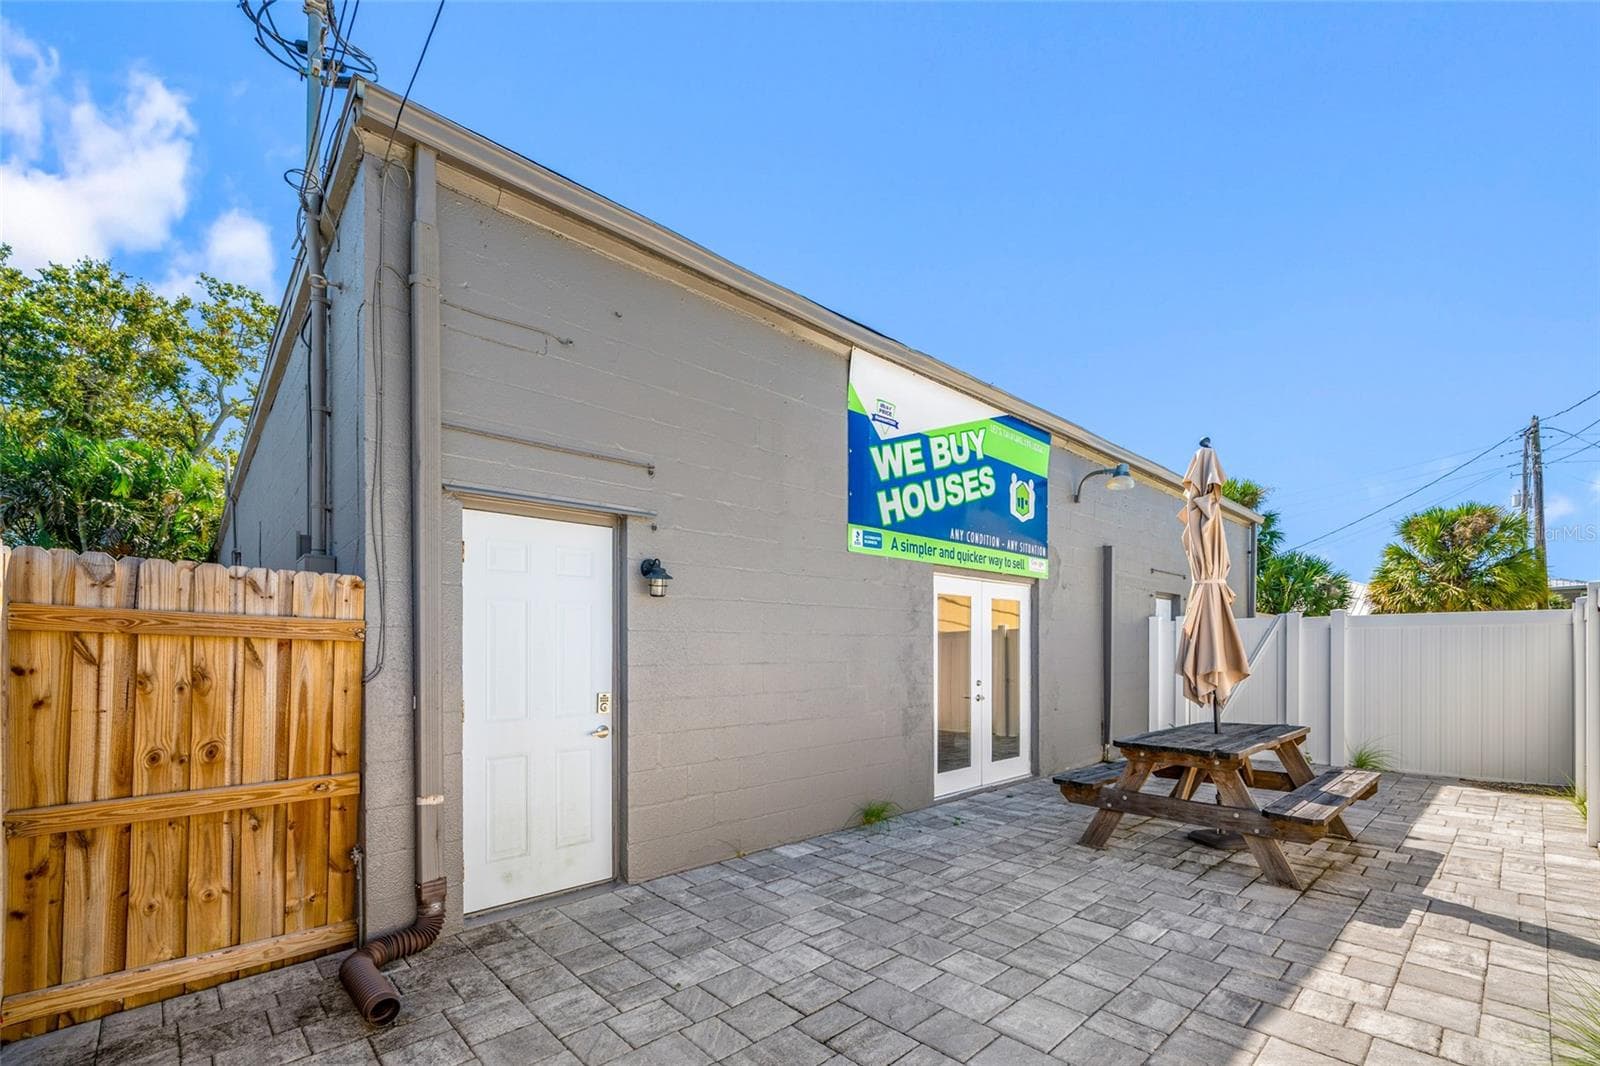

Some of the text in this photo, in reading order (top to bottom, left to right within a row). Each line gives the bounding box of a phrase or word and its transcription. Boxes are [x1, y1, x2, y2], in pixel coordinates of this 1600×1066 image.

[869, 439, 926, 481] WE
[928, 428, 986, 470] BUY
[876, 465, 996, 526] HOUSES
[890, 536, 899, 551] A
[900, 539, 937, 557] simpler
[939, 547, 955, 560] and
[956, 550, 987, 564] quicker
[988, 557, 1003, 569] way
[1004, 557, 1012, 568] to
[1012, 557, 1025, 570] sell
[949, 528, 965, 541] ANY
[966, 530, 1000, 548] CONDITION
[1007, 539, 1018, 551] ANY
[1019, 542, 1046, 557] SITUATION
